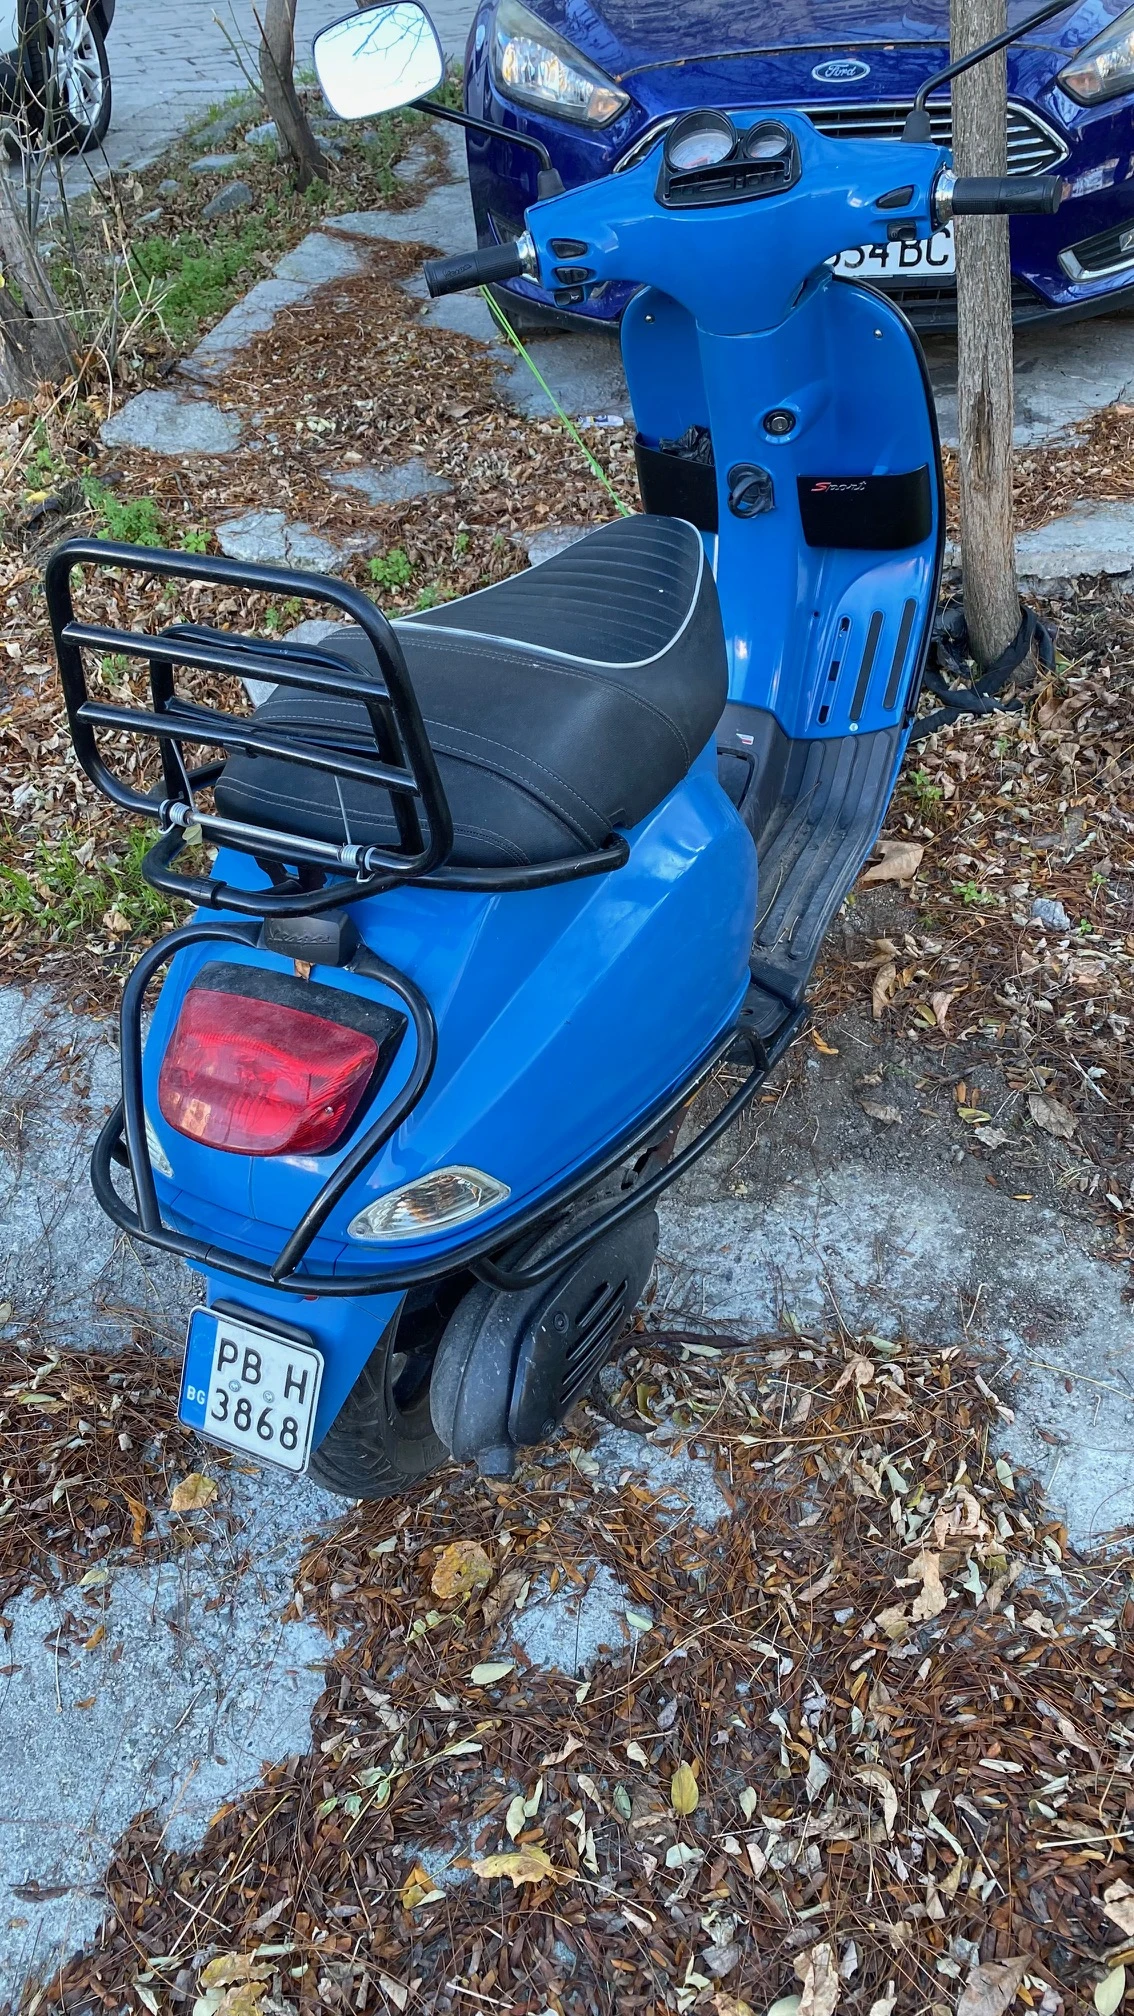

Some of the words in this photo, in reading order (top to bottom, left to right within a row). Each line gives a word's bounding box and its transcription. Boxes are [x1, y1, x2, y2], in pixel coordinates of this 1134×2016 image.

[825, 64, 857, 78] Ford
[898, 227, 951, 268] BC
[811, 481, 867, 492] Sport
[216, 1337, 262, 1386] PB
[283, 1363, 309, 1405] H
[187, 1384, 206, 1406] BG
[210, 1388, 299, 1451] 3868
